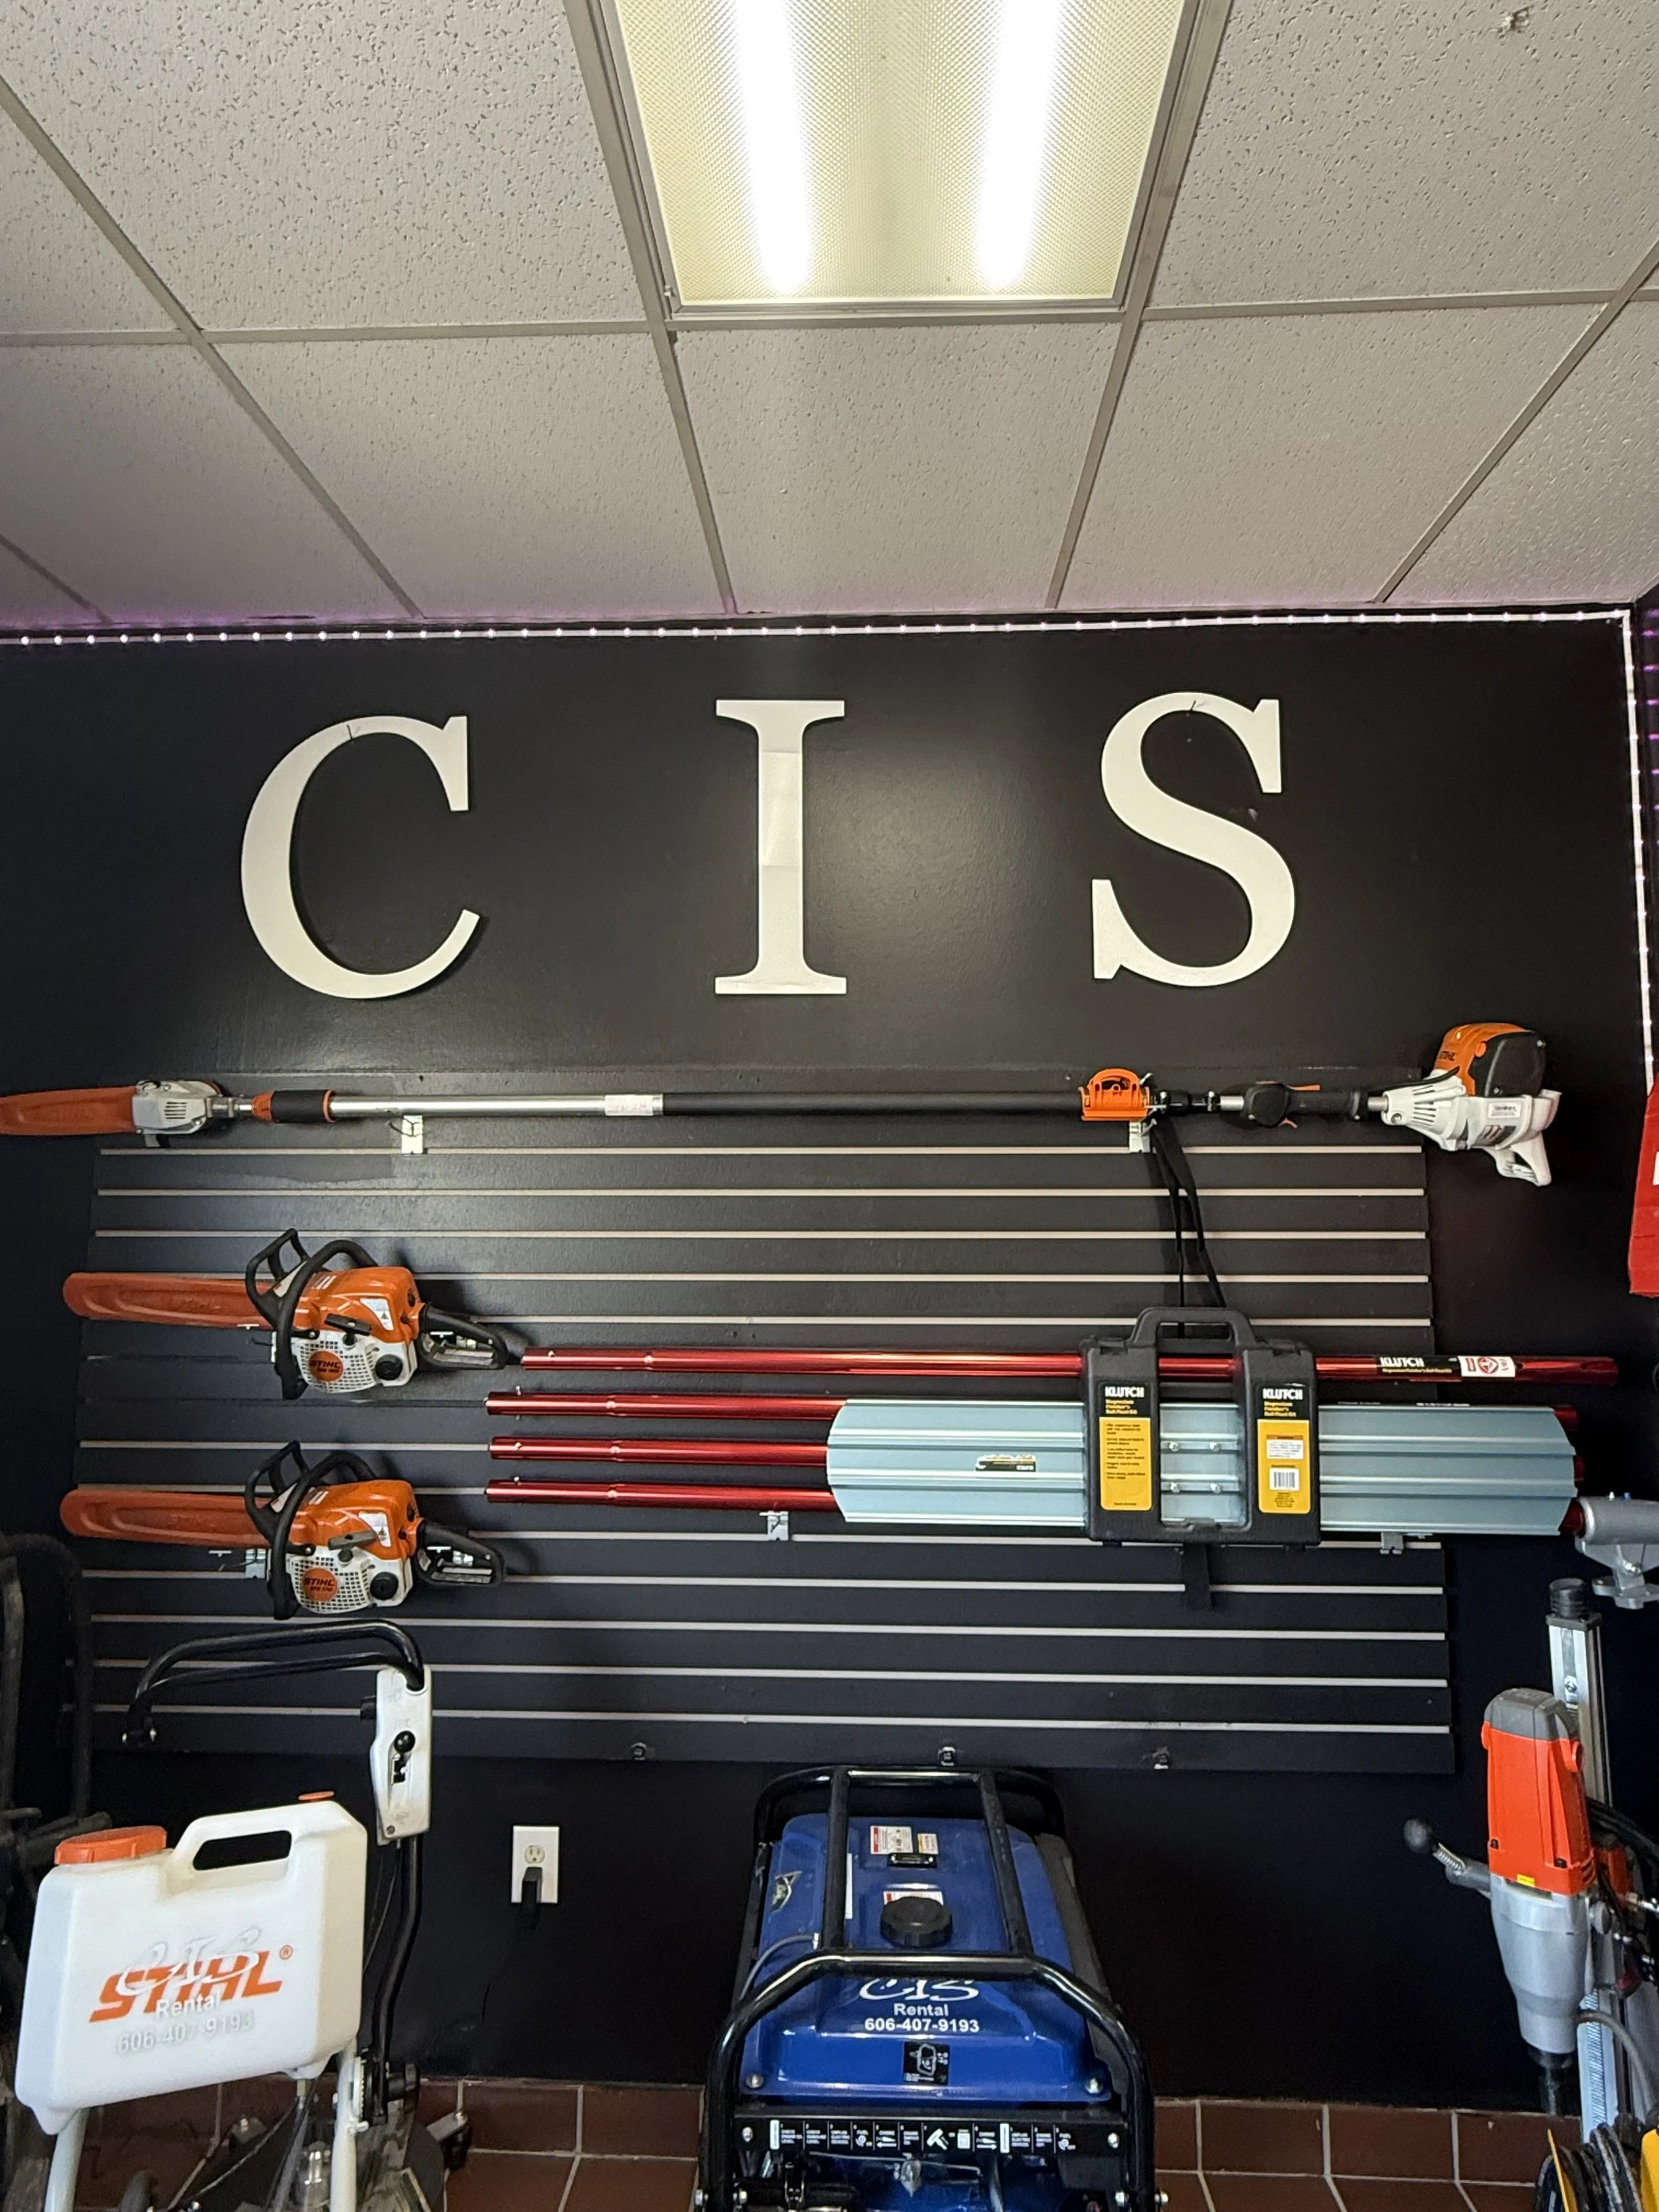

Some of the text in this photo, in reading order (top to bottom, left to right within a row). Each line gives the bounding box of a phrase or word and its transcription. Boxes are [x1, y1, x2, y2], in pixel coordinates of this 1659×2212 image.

[1380, 1357, 1425, 1367] KLUTCH
[1105, 1386, 1144, 1398] KLUTCH
[1263, 1388, 1303, 1400] KLUTCH
[305, 1578, 334, 1586] STIHL
[89, 1951, 283, 2023] STIHL
[155, 1991, 220, 2020] Rental
[893, 2003, 948, 2016] Rental
[865, 2018, 979, 2032] 606-407-9193
